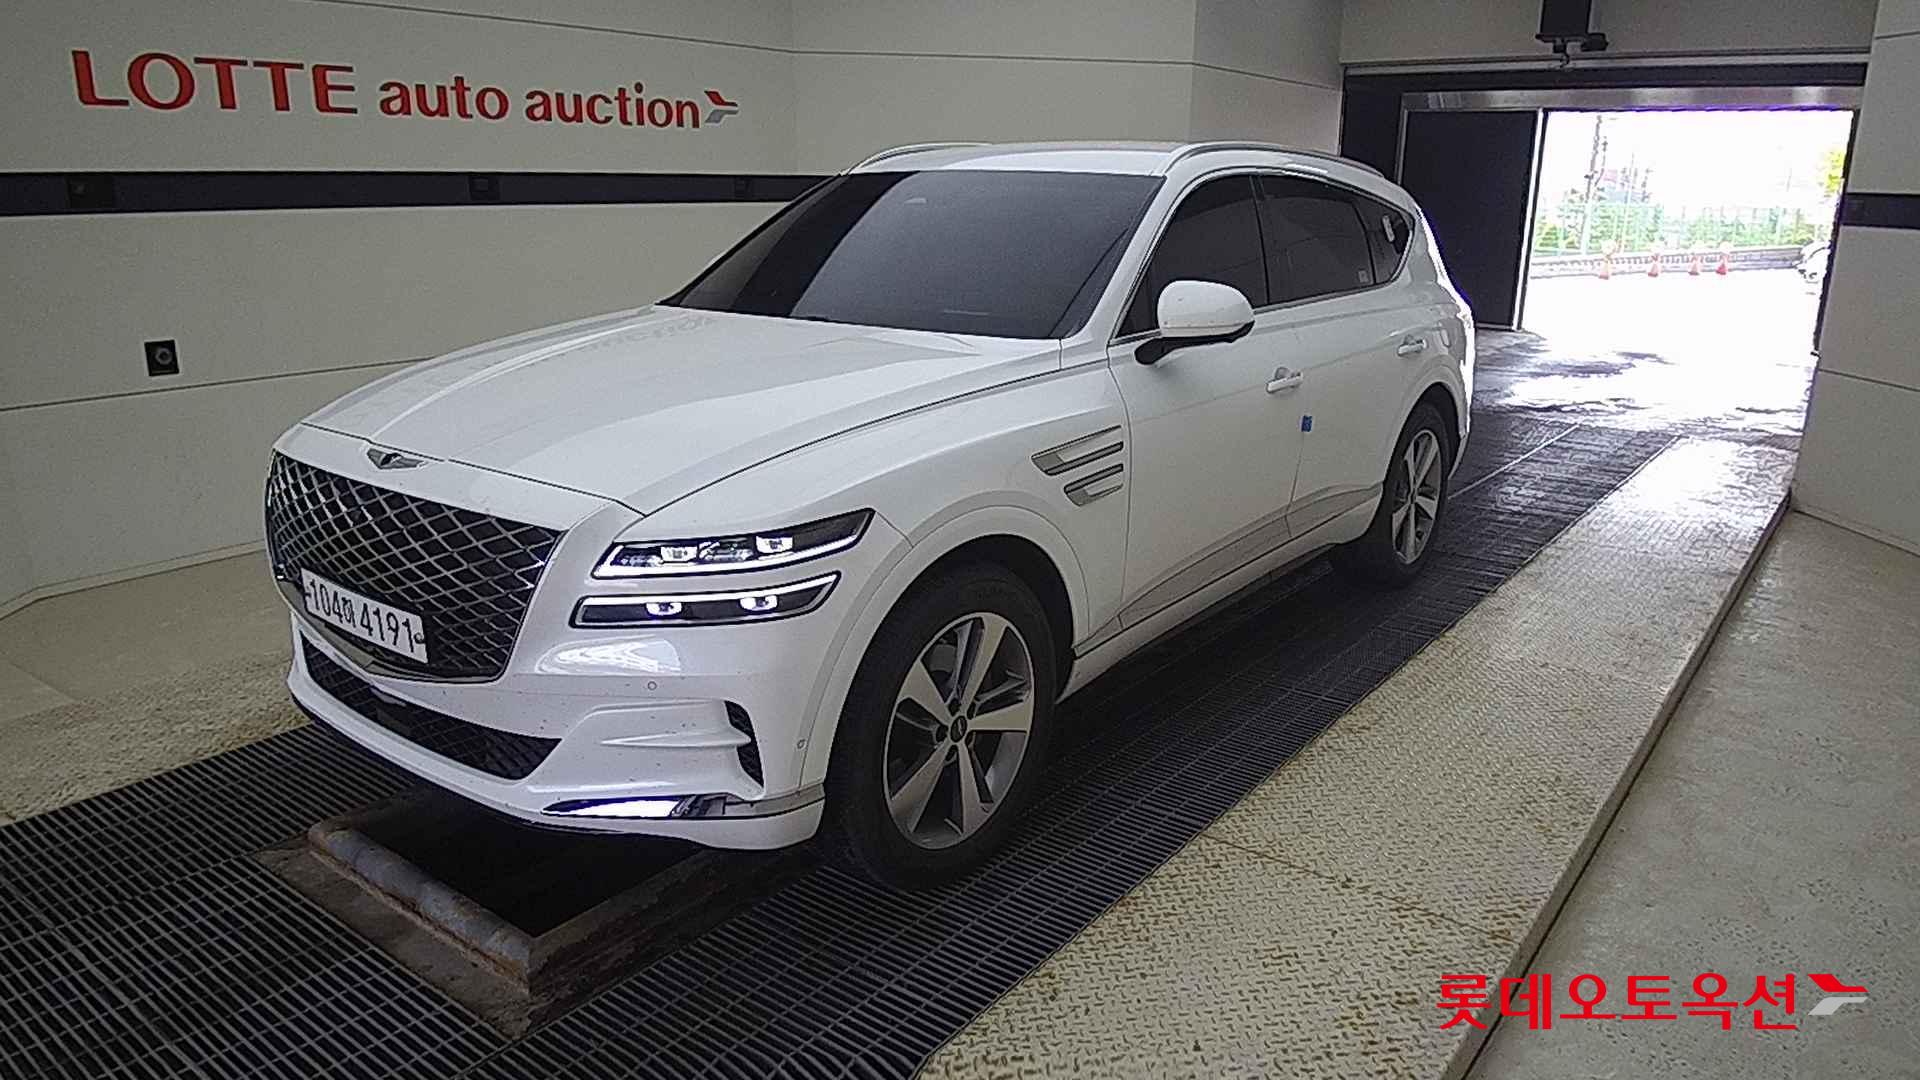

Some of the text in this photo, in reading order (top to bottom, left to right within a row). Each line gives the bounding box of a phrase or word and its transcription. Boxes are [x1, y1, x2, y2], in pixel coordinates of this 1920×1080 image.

[73, 50, 701, 129] LOTTE auto auction
[360, 602, 414, 653] 4191
